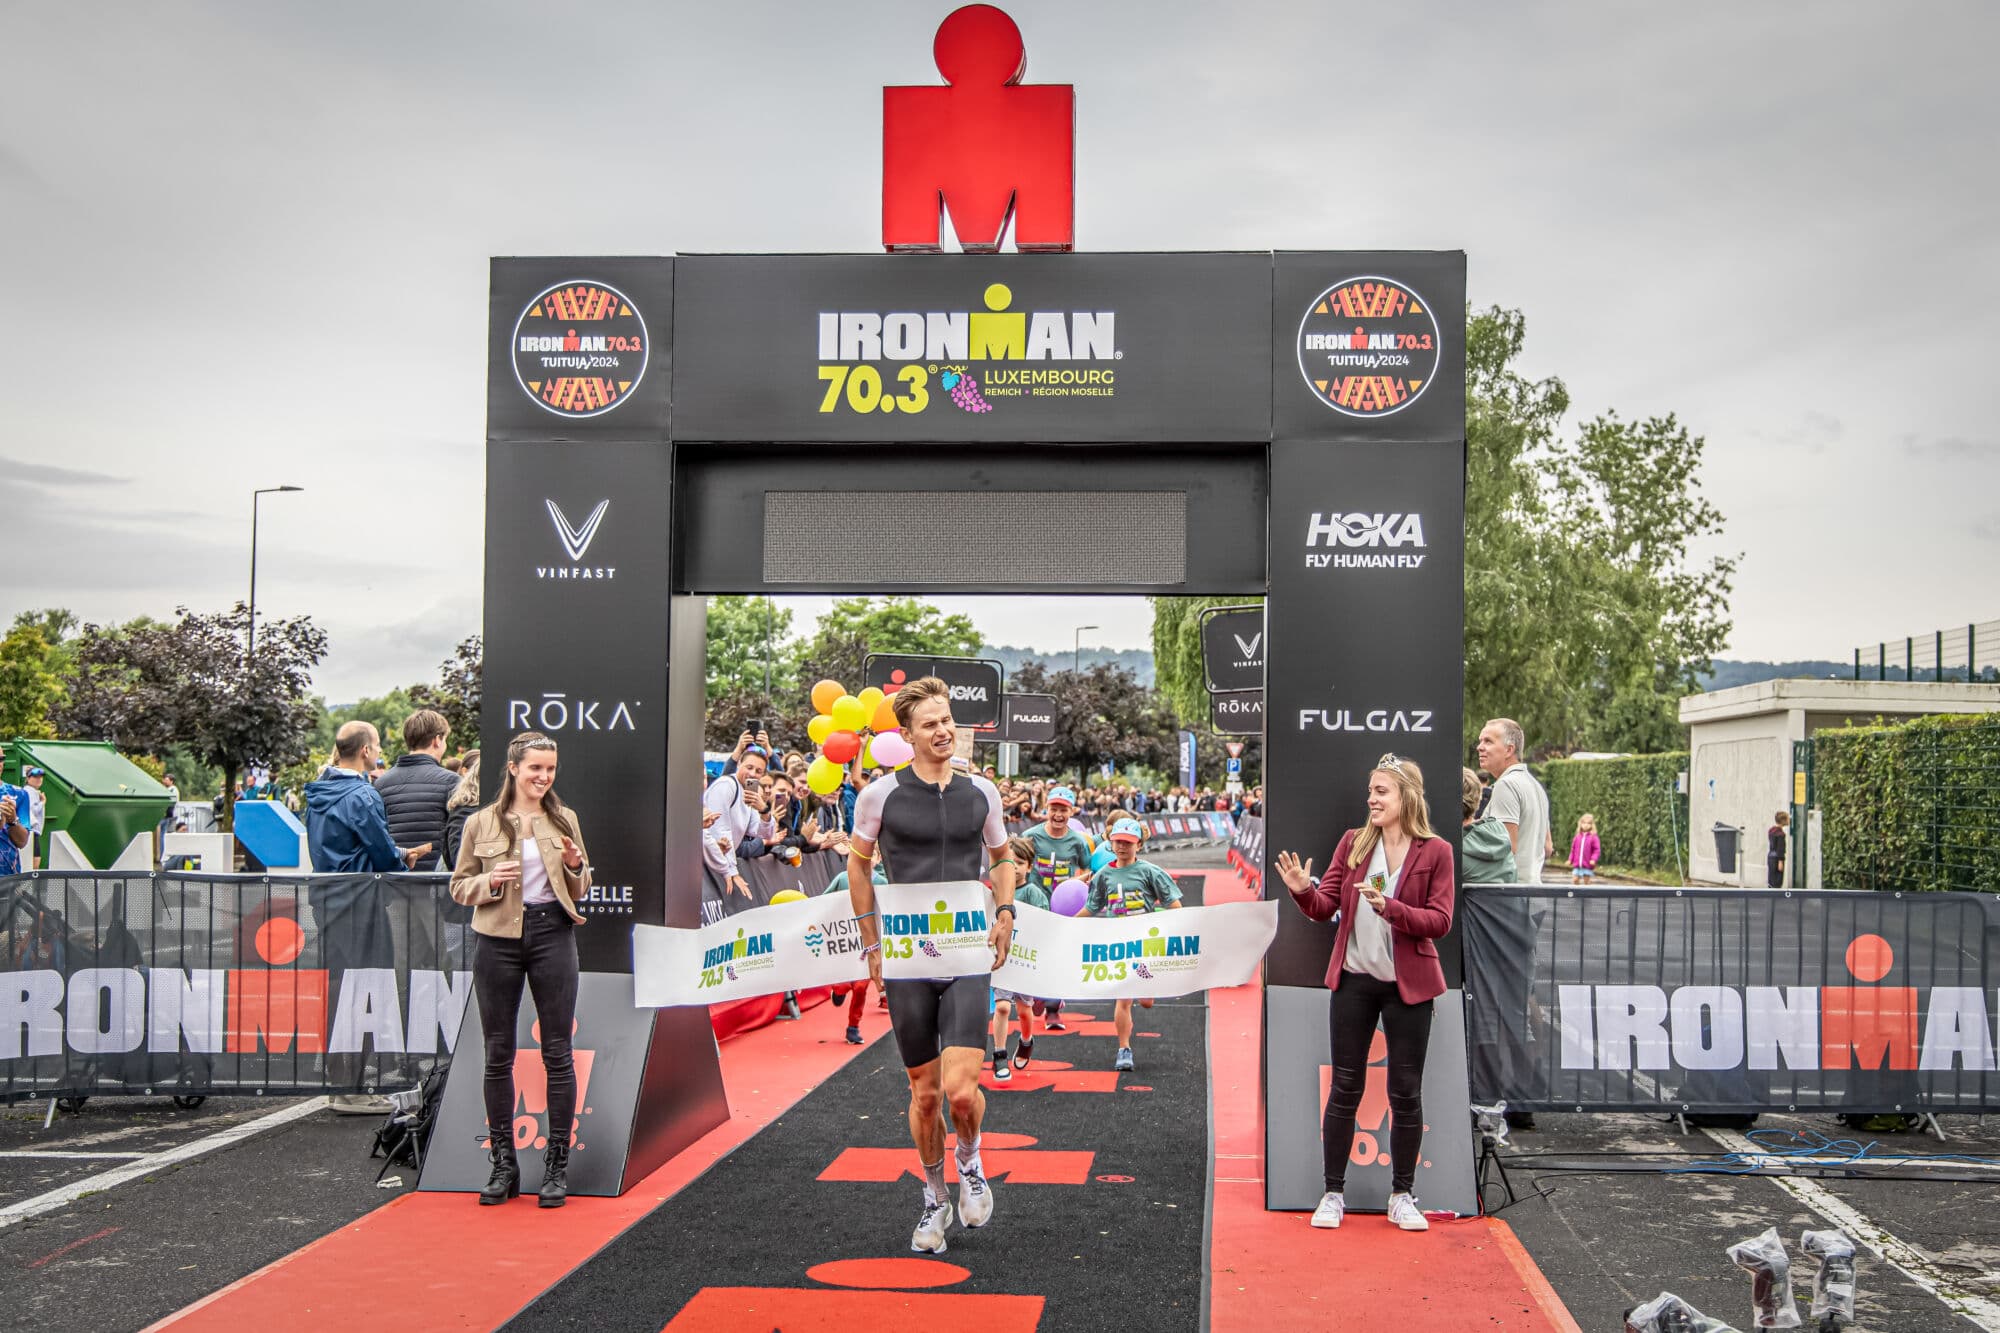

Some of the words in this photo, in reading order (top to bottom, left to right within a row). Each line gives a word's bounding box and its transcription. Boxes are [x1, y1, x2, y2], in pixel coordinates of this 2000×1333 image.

[819, 283, 1115, 361] IRONMAN
[520, 329, 607, 352] IRONMAN
[607, 336, 641, 352] 70.3
[1305, 326, 1396, 350] IRONMAN
[1396, 334, 1431, 350] 70.3
[592, 357, 619, 368] 2024
[1381, 355, 1409, 366] 2024
[985, 370, 1114, 384] LUXEMBOURG
[818, 365, 930, 414] 70.3
[985, 388, 1021, 396] REMICH
[1033, 386, 1069, 396] RÉGION
[1071, 388, 1114, 396] MOSELLE
[1306, 512, 1425, 547] HOKA
[1305, 554, 1331, 568] FLY
[1334, 554, 1395, 568] HUMAN
[1397, 554, 1423, 568] FLY
[537, 568, 616, 578] VINFAST
[1013, 714, 1050, 723] FULGAZ
[1299, 709, 1432, 732] FULGAZ
[821, 918, 858, 937] VISIT
[703, 928, 773, 970] IRONMAN
[827, 936, 864, 955] REMI
[1008, 944, 1038, 961] ELLE
[1082, 927, 1200, 962] IRONMAN
[698, 965, 724, 988] 70.3
[1081, 962, 1127, 982] 70.3
[0, 917, 474, 1059] RONMAN
[1558, 934, 2000, 1071] IRONMA
